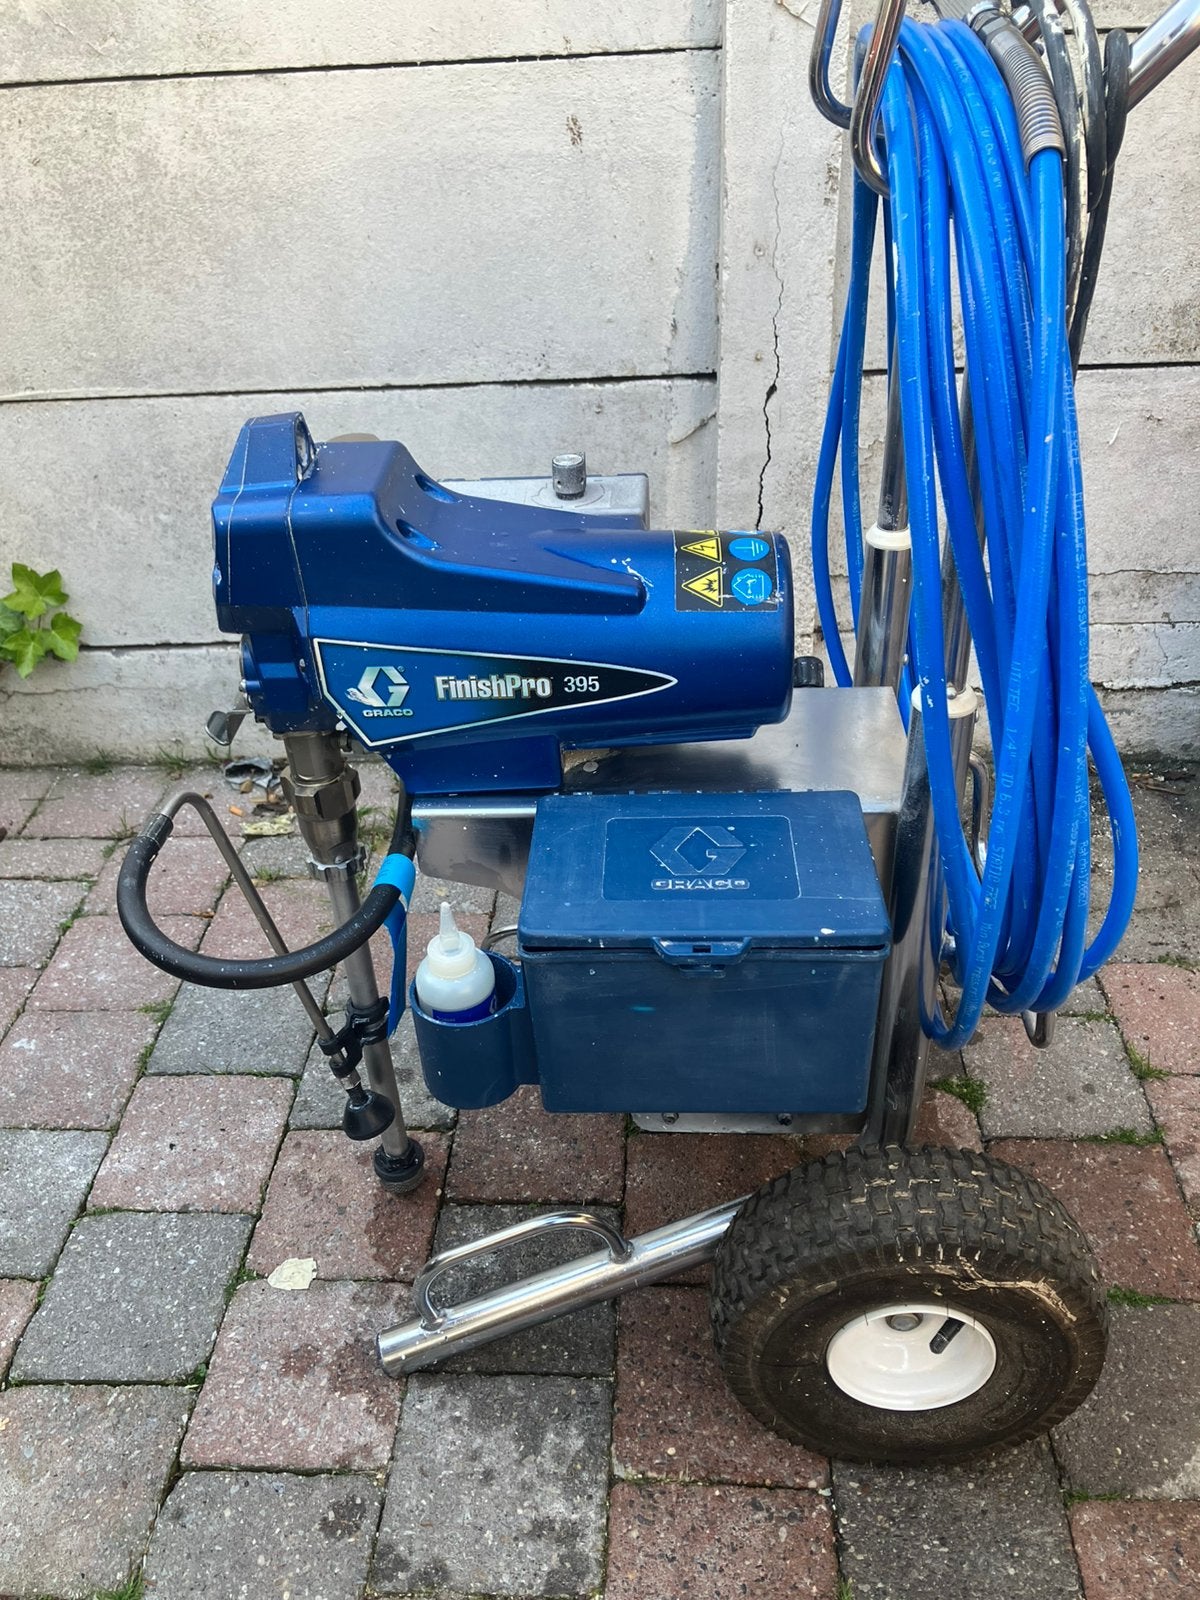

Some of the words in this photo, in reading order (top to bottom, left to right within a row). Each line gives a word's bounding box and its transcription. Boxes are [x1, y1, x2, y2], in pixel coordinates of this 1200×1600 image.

[434, 674, 552, 700] FinishPro
[563, 675, 600, 693] 395
[362, 708, 414, 718] GRACO
[1004, 726, 1018, 758] 1/4"
[1001, 773, 1015, 789] ID
[989, 845, 1005, 884] STATIC
[650, 878, 751, 891] GRACO
